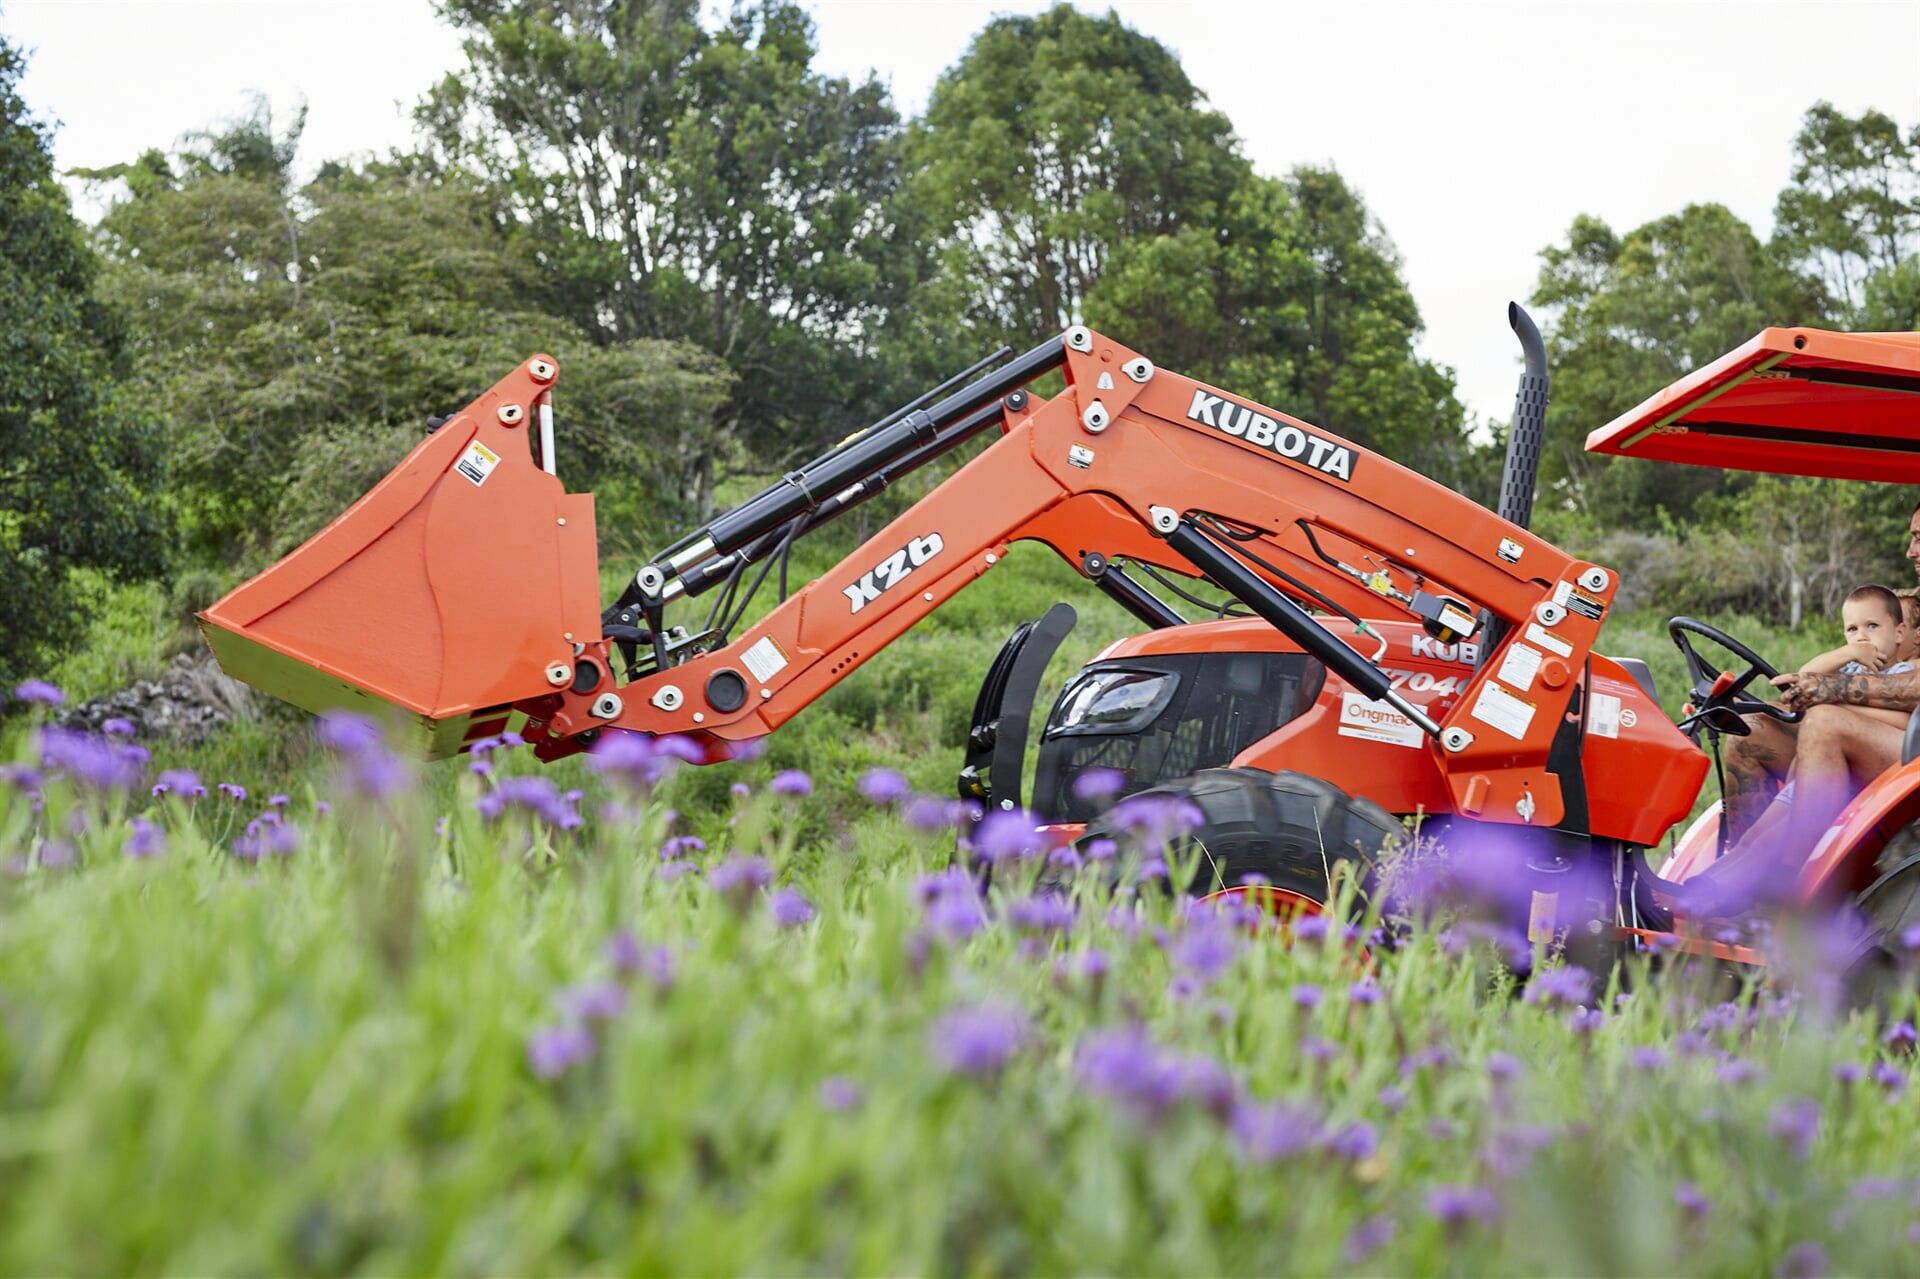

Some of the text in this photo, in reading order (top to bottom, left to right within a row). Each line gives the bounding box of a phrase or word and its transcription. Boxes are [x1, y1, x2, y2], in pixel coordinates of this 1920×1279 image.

[1187, 389, 1350, 481] KUBOTA
[843, 533, 944, 614] X26
[1411, 634, 1479, 665] KUB
[1380, 667, 1471, 697] 704
